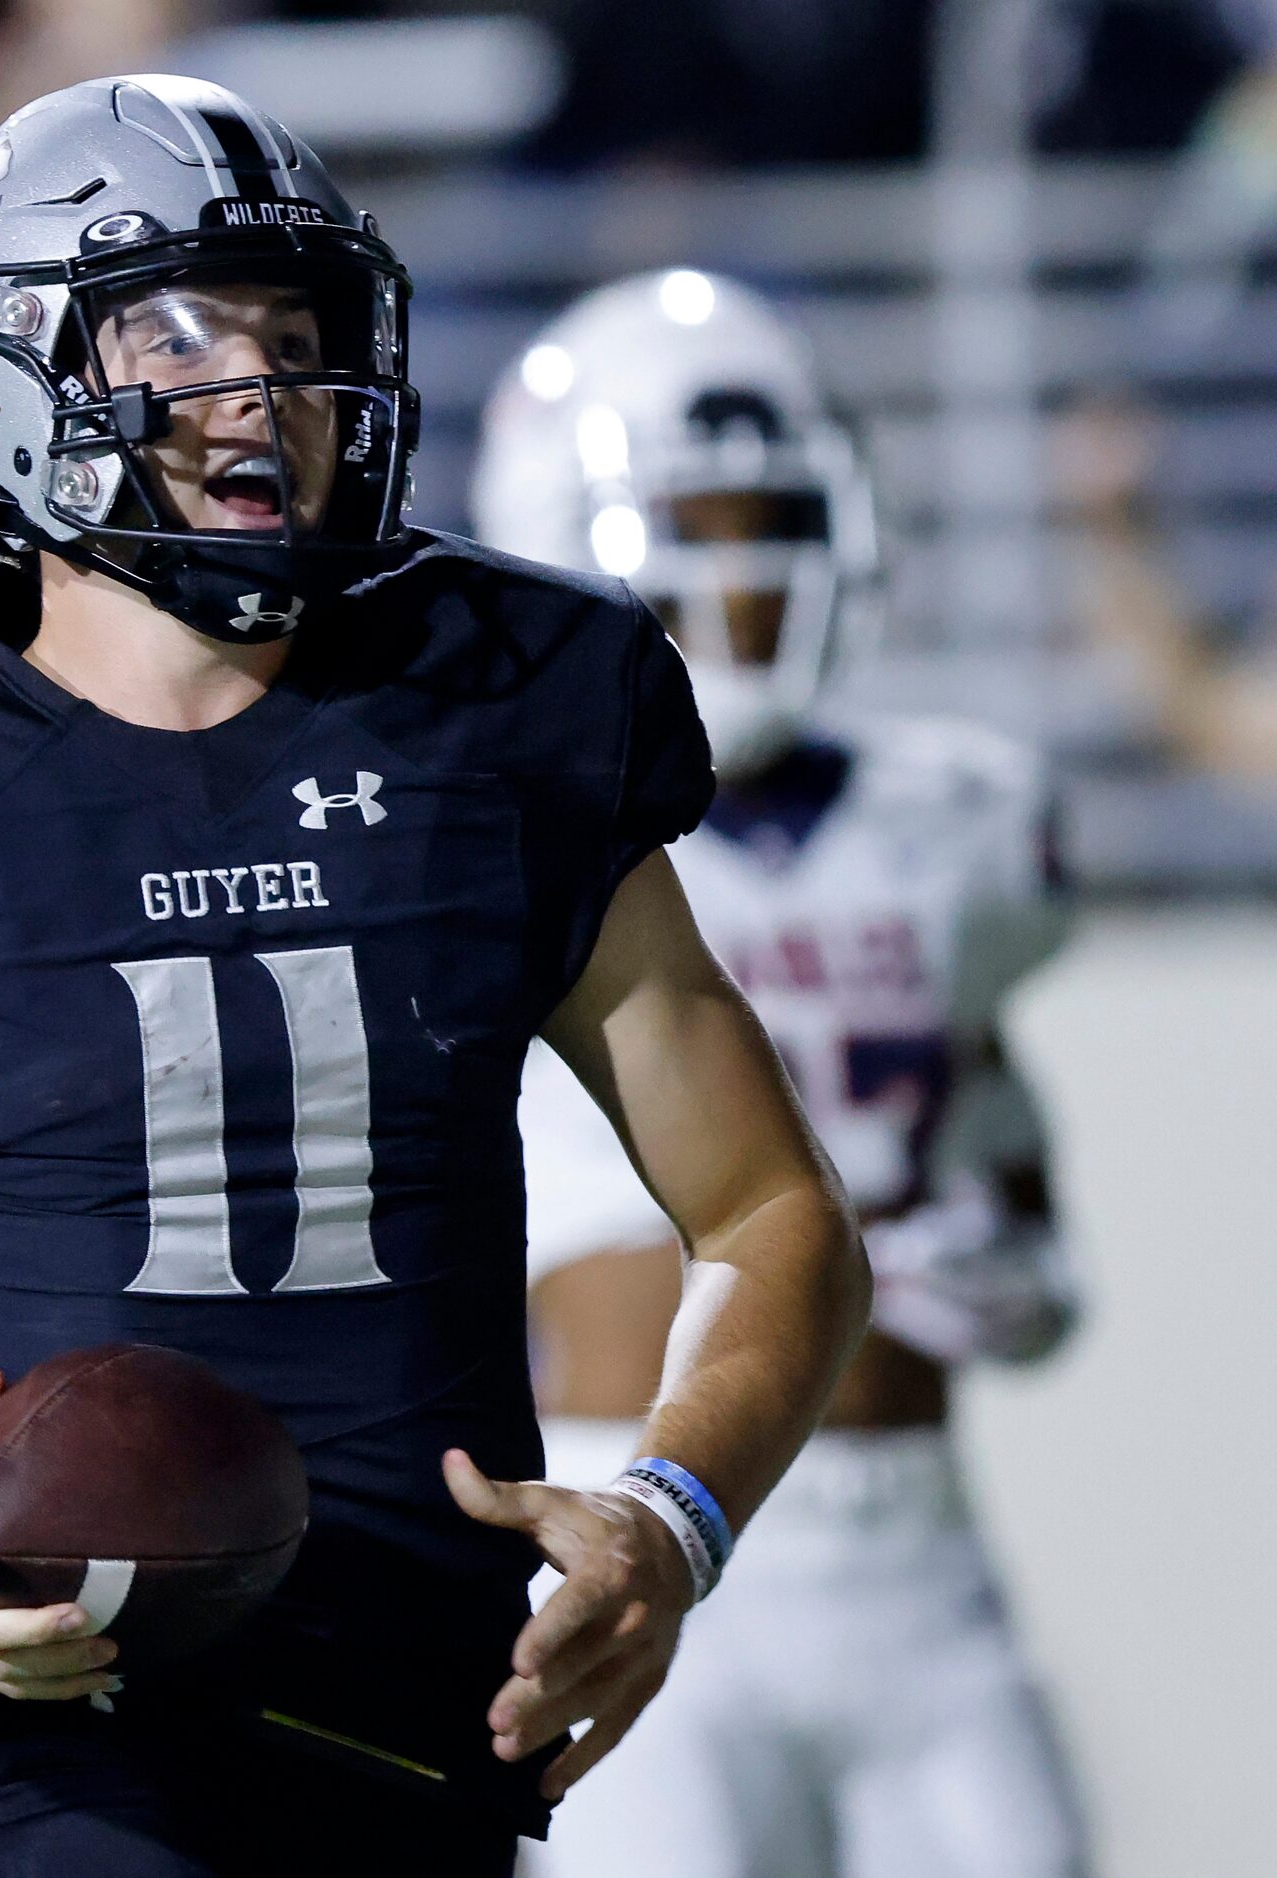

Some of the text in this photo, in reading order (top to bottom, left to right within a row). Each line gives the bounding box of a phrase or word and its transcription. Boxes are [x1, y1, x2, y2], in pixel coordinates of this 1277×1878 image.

[222, 203, 324, 226] WILDCATS
[140, 861, 330, 921] GUYER
[110, 945, 393, 1295] 11
